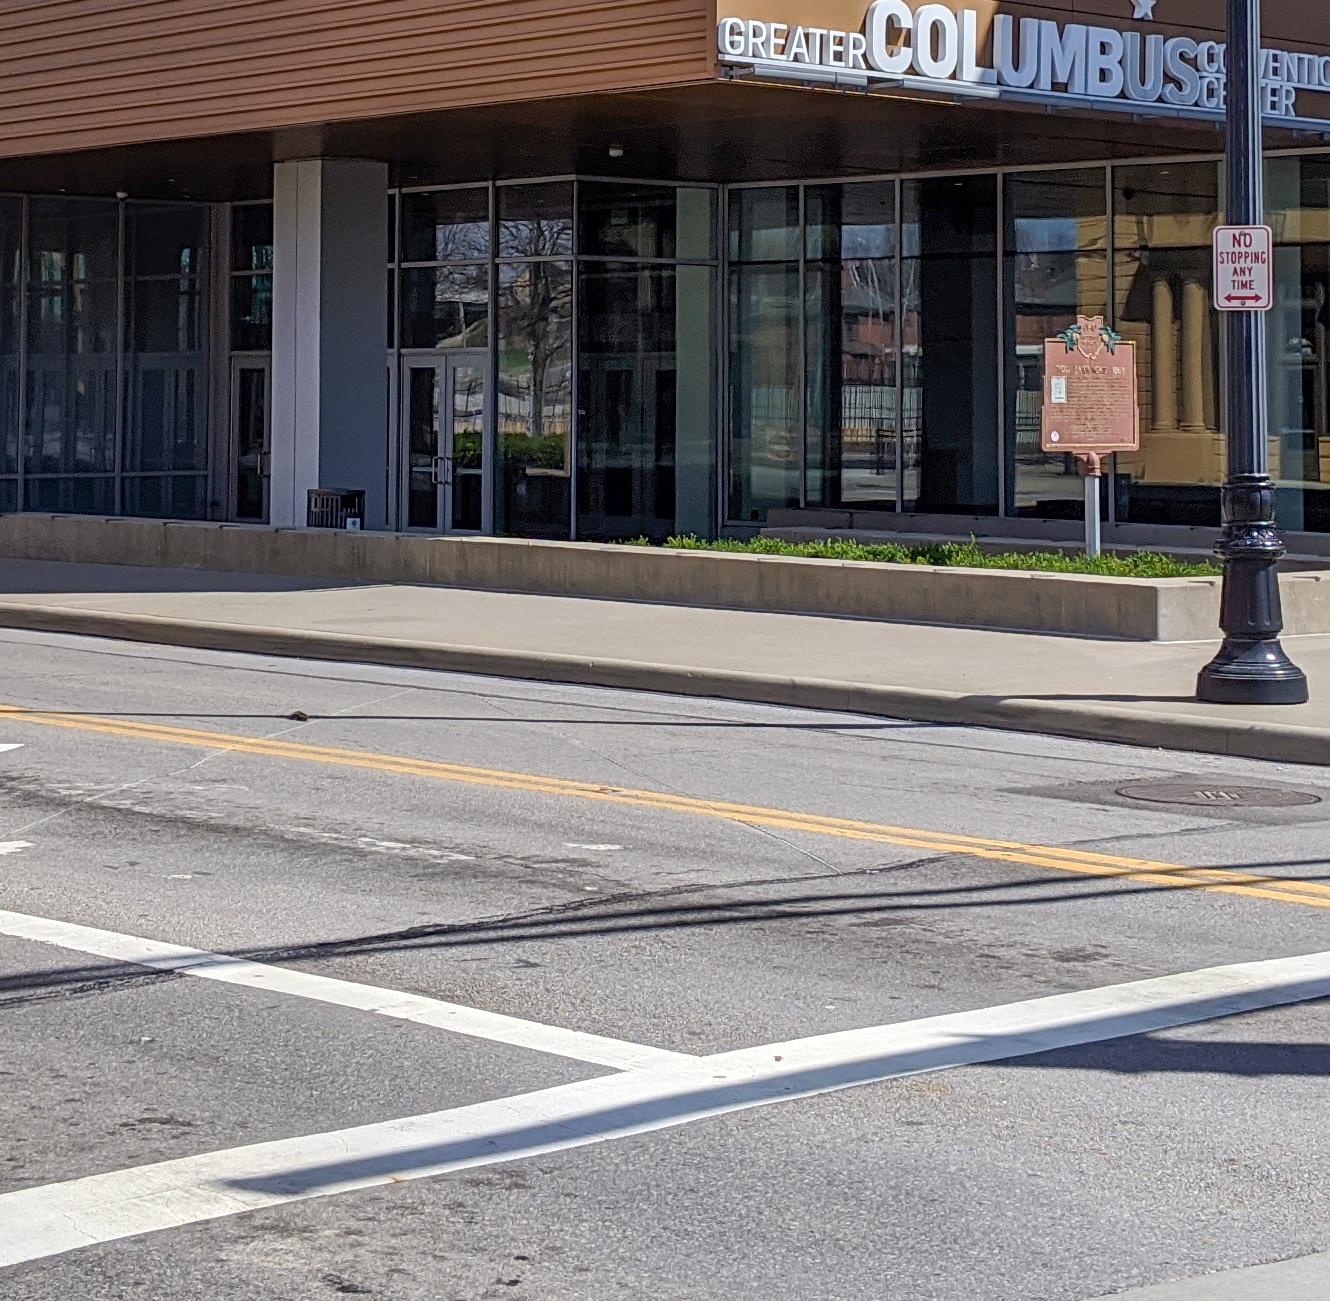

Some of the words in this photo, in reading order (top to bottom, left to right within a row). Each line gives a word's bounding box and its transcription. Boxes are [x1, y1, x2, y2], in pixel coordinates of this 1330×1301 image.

[720, 17, 867, 69] GREATER
[1198, 77, 1296, 117] CEER
[1232, 232, 1253, 249] NO
[1219, 250, 1267, 265] STOPPING
[1232, 266, 1254, 278] ANY
[1230, 279, 1256, 291] TIME
